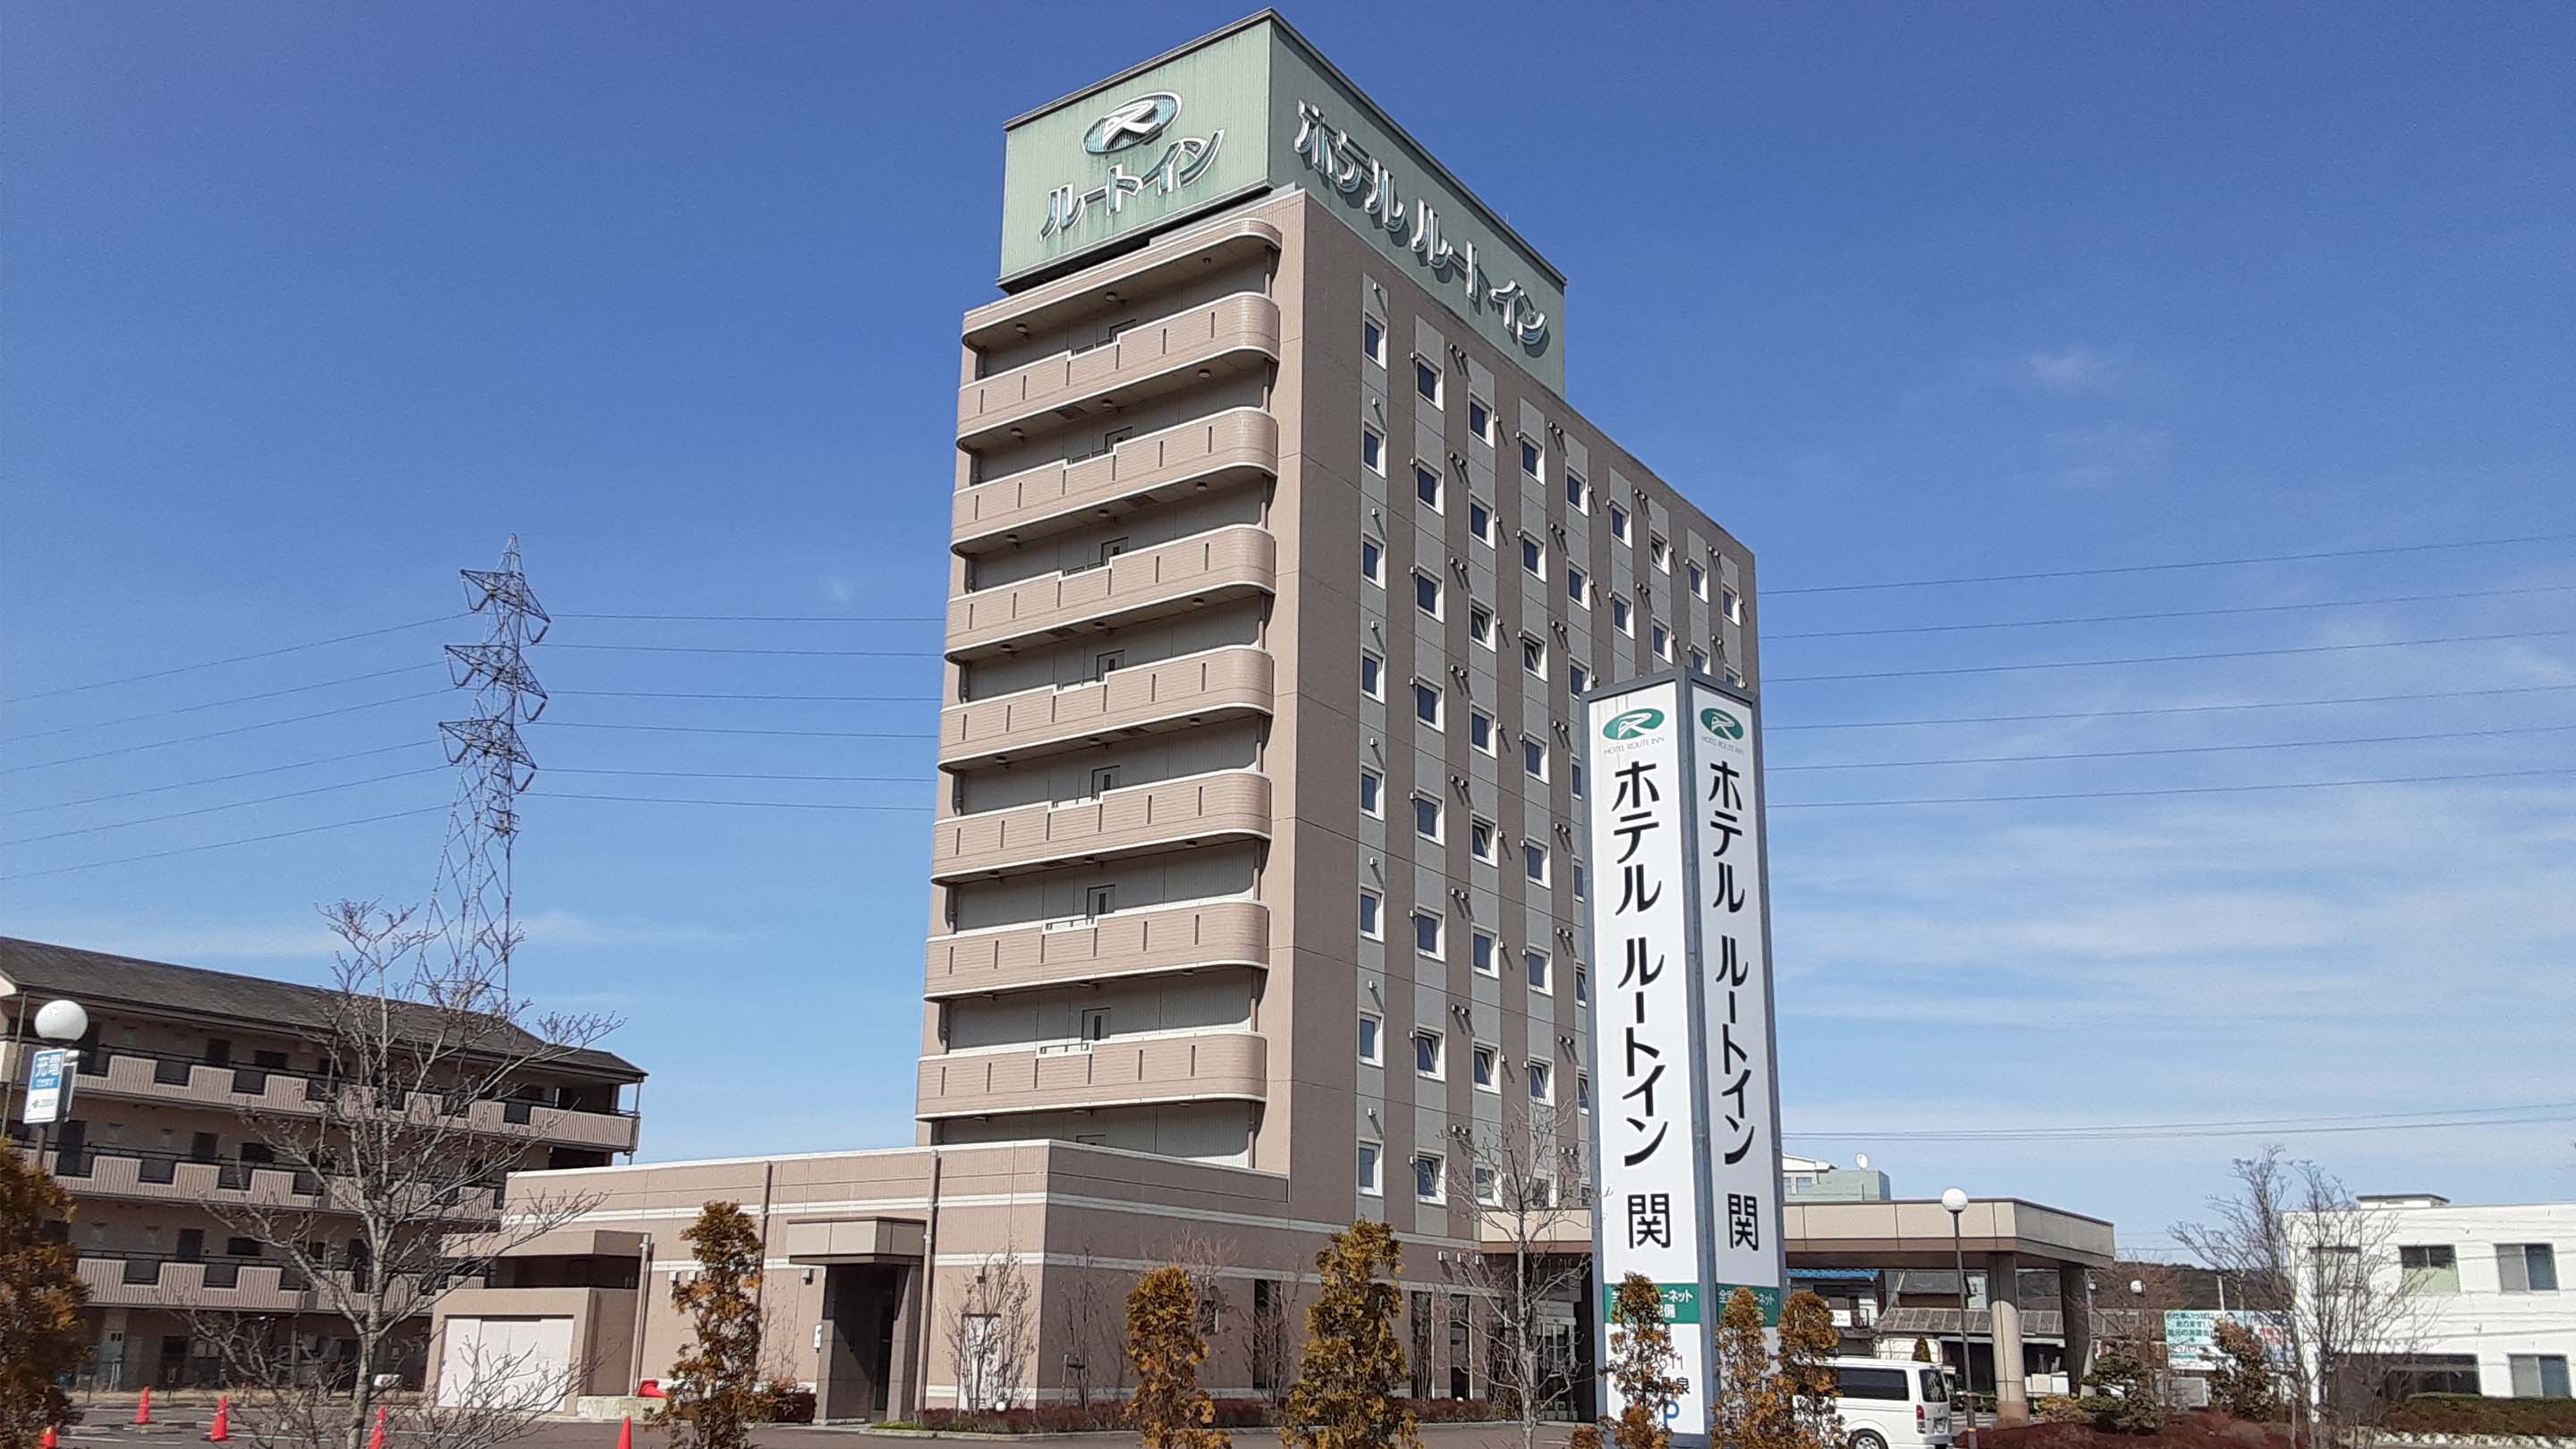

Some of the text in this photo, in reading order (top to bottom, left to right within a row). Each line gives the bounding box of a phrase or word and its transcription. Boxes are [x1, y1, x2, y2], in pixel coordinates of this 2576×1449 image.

[1038, 129, 1225, 242] ルートイン
[1603, 744, 1625, 756] HOTEL
[1628, 1193, 1671, 1249] 関
[1728, 1193, 1759, 1251] 関
